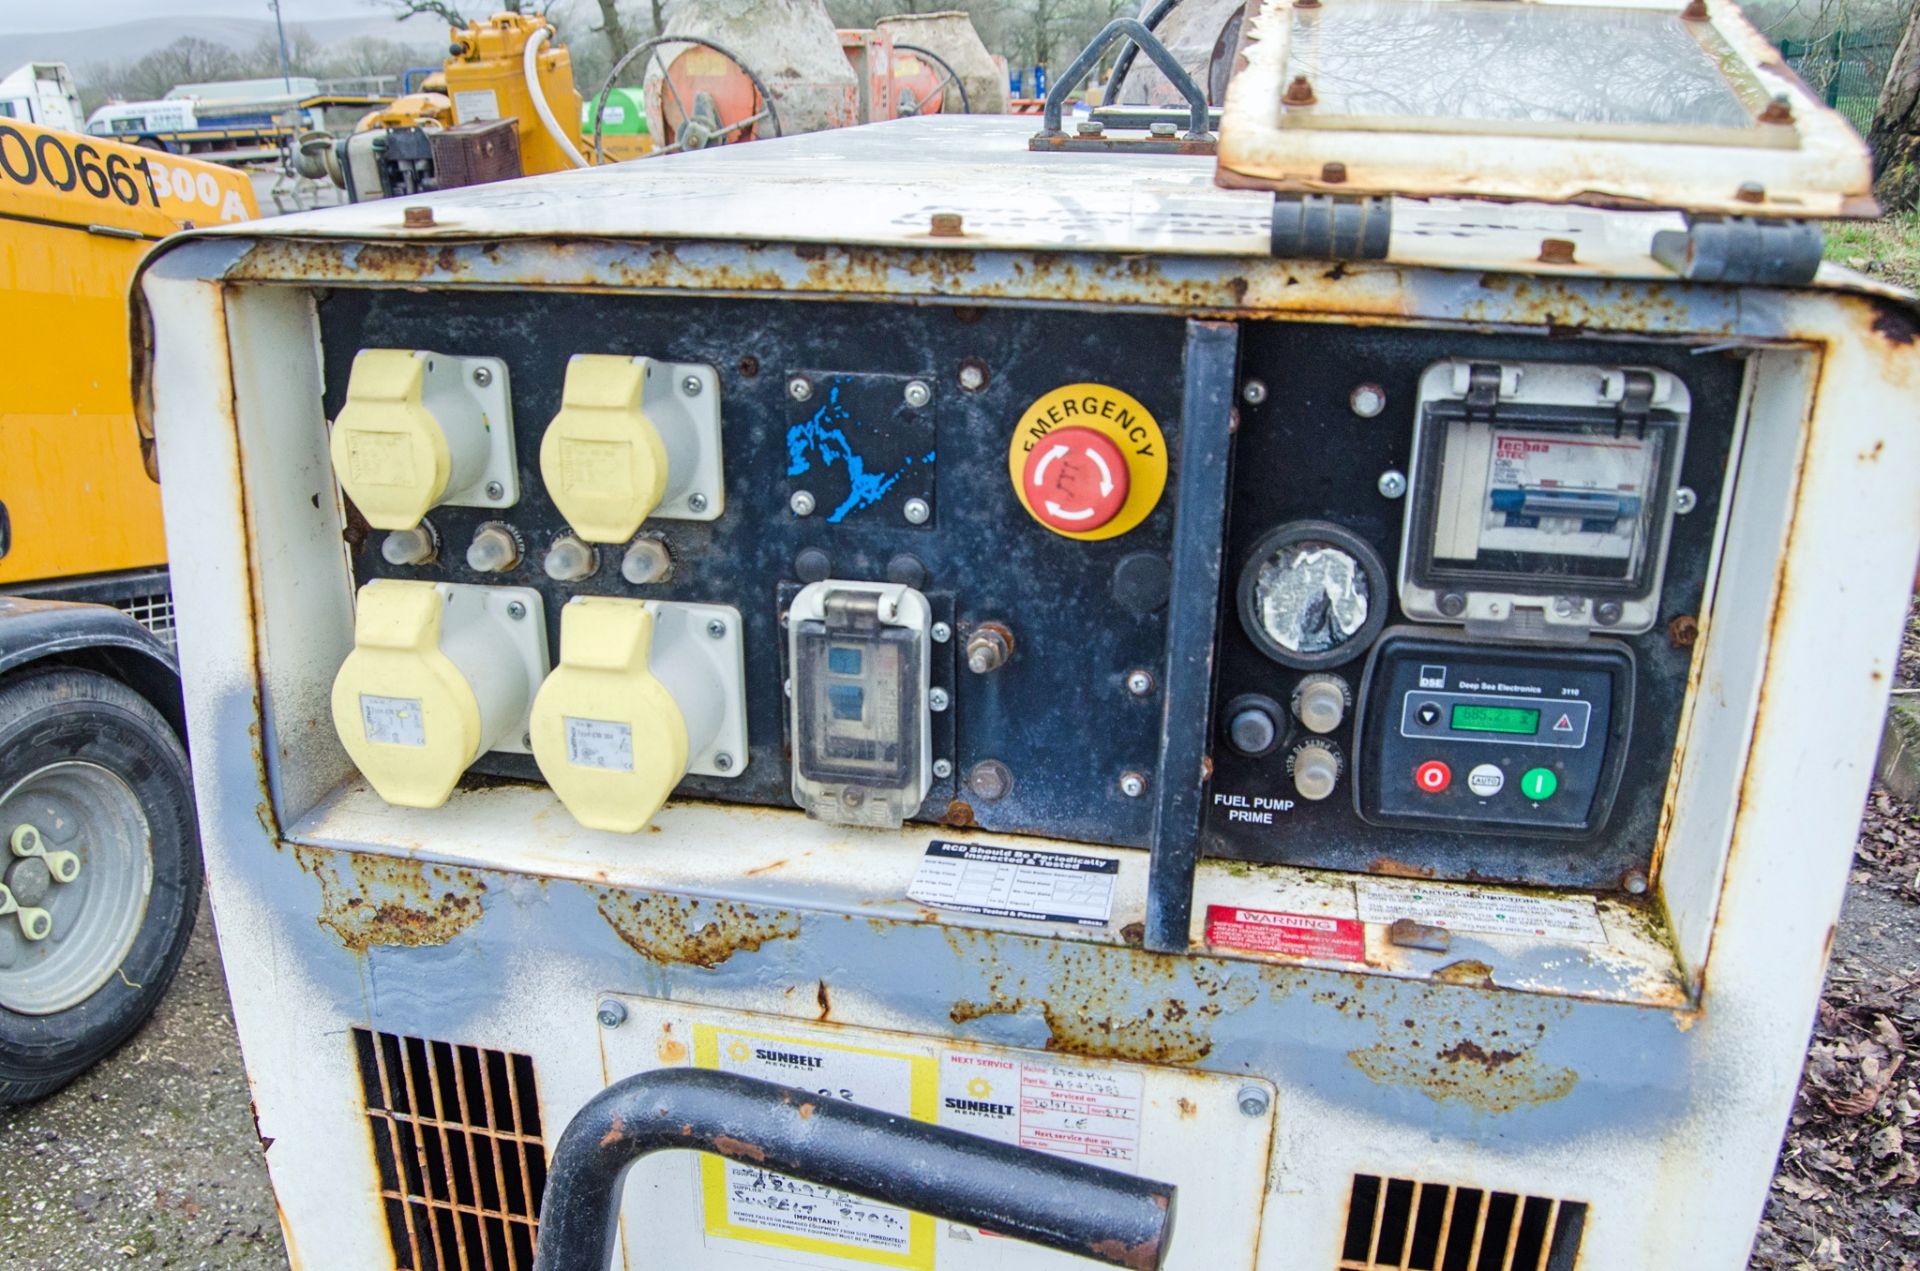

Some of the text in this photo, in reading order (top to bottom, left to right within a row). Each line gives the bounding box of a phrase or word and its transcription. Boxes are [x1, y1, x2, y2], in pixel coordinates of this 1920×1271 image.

[0, 125, 160, 207] 00661
[1023, 396, 1154, 458] EMERGENCY
[1459, 681, 1543, 695] Deep Sea Electronics
[1214, 794, 1295, 812] FUEL PUMP
[1229, 810, 1273, 825] PRIME
[942, 843, 1108, 868] RCD Should Be Periodically
[963, 851, 1024, 866] Inspected
[1037, 859, 1081, 870] Tested
[1242, 912, 1331, 929] WARNING
[756, 1049, 824, 1069] SUNBELT
[951, 1056, 1014, 1070] NEXT SERVICE
[1050, 1091, 1085, 1102] Serviced
[945, 1097, 1014, 1117] SUNBELT
[954, 1109, 1005, 1120] RENTALS
[1034, 1130, 1053, 1139] Next
[1054, 1133, 1083, 1142] service
[794, 1212, 841, 1226] IMPORTANT!
